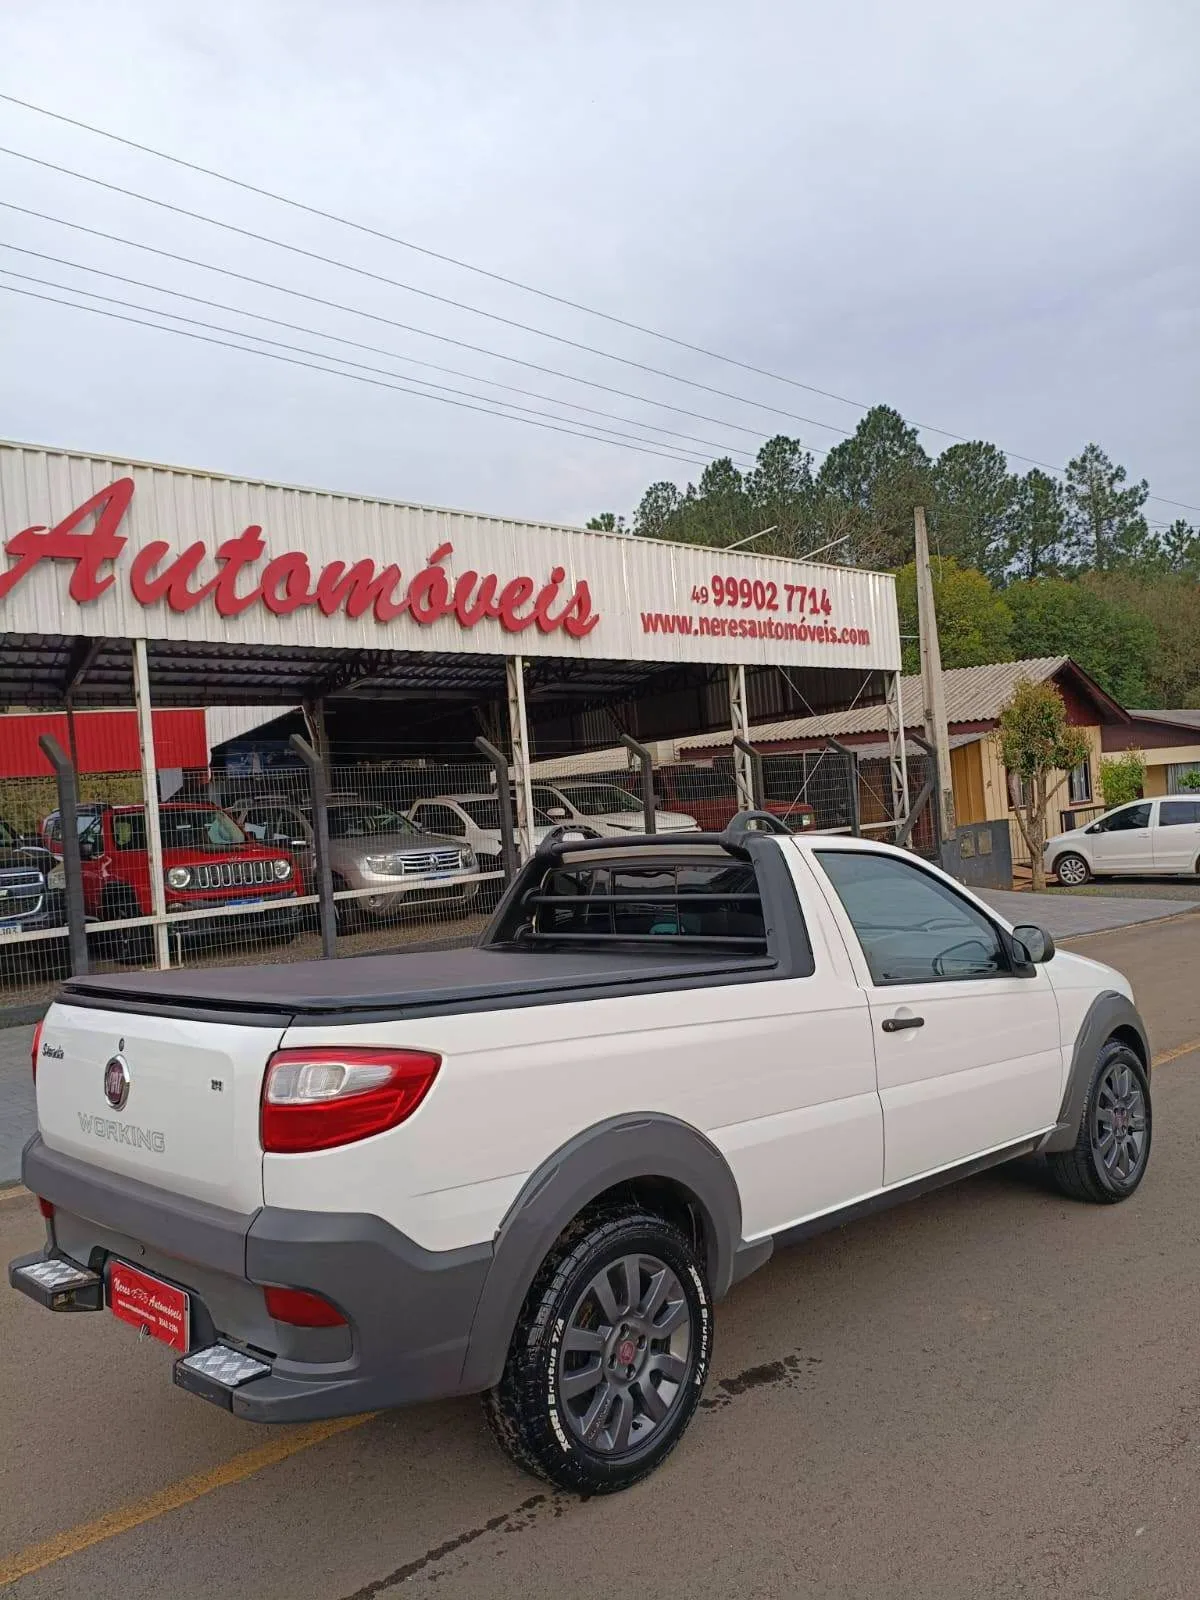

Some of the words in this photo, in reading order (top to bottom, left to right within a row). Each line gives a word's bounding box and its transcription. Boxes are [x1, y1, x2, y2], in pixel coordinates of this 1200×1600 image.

[0, 477, 600, 638] Automóveis
[691, 585, 709, 604] 49
[711, 575, 778, 611] 99902
[783, 584, 832, 615] 7714
[640, 612, 870, 646] www.neresautomóveis.com
[78, 1112, 165, 1152] WORKING
